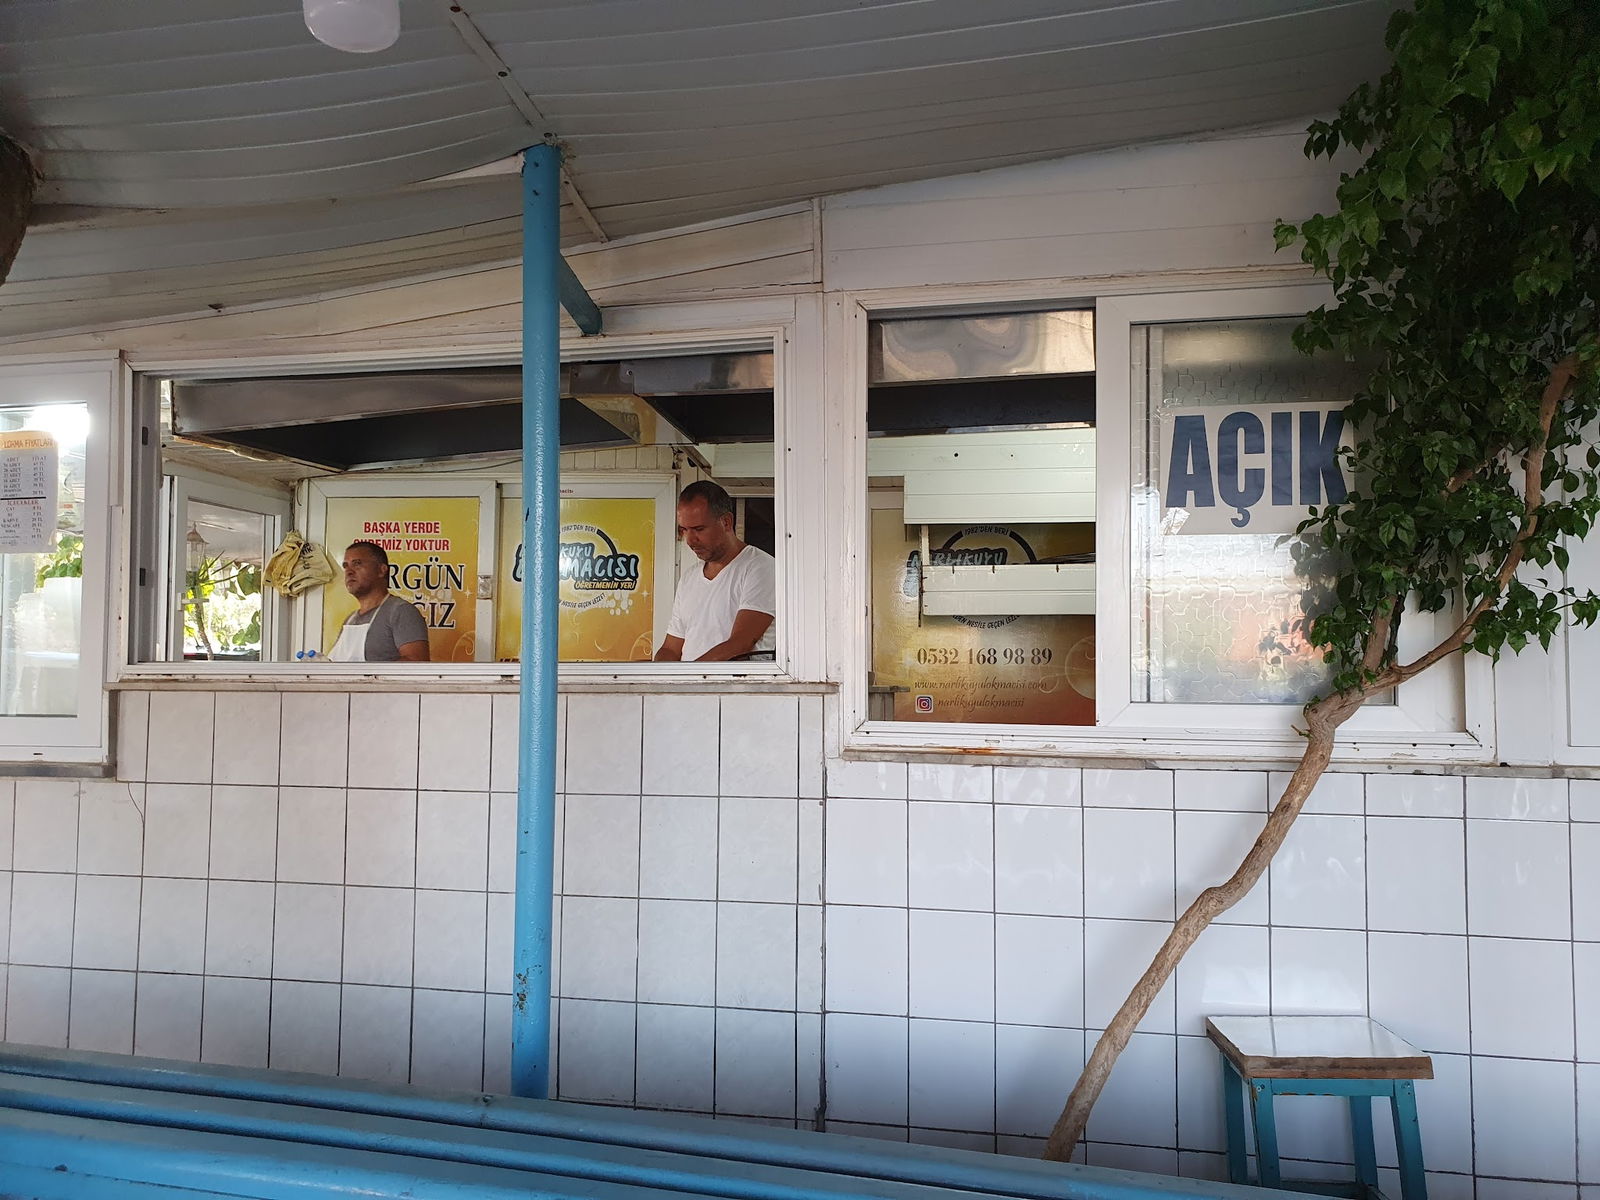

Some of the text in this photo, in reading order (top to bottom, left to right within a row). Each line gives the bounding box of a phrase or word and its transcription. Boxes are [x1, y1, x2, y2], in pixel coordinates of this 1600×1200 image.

[1166, 411, 1350, 528] AÇIK
[364, 522, 440, 536] BAŞKA YERDE
[406, 539, 450, 551] YOKTUR
[917, 648, 1053, 666] 0532 168 98 89
